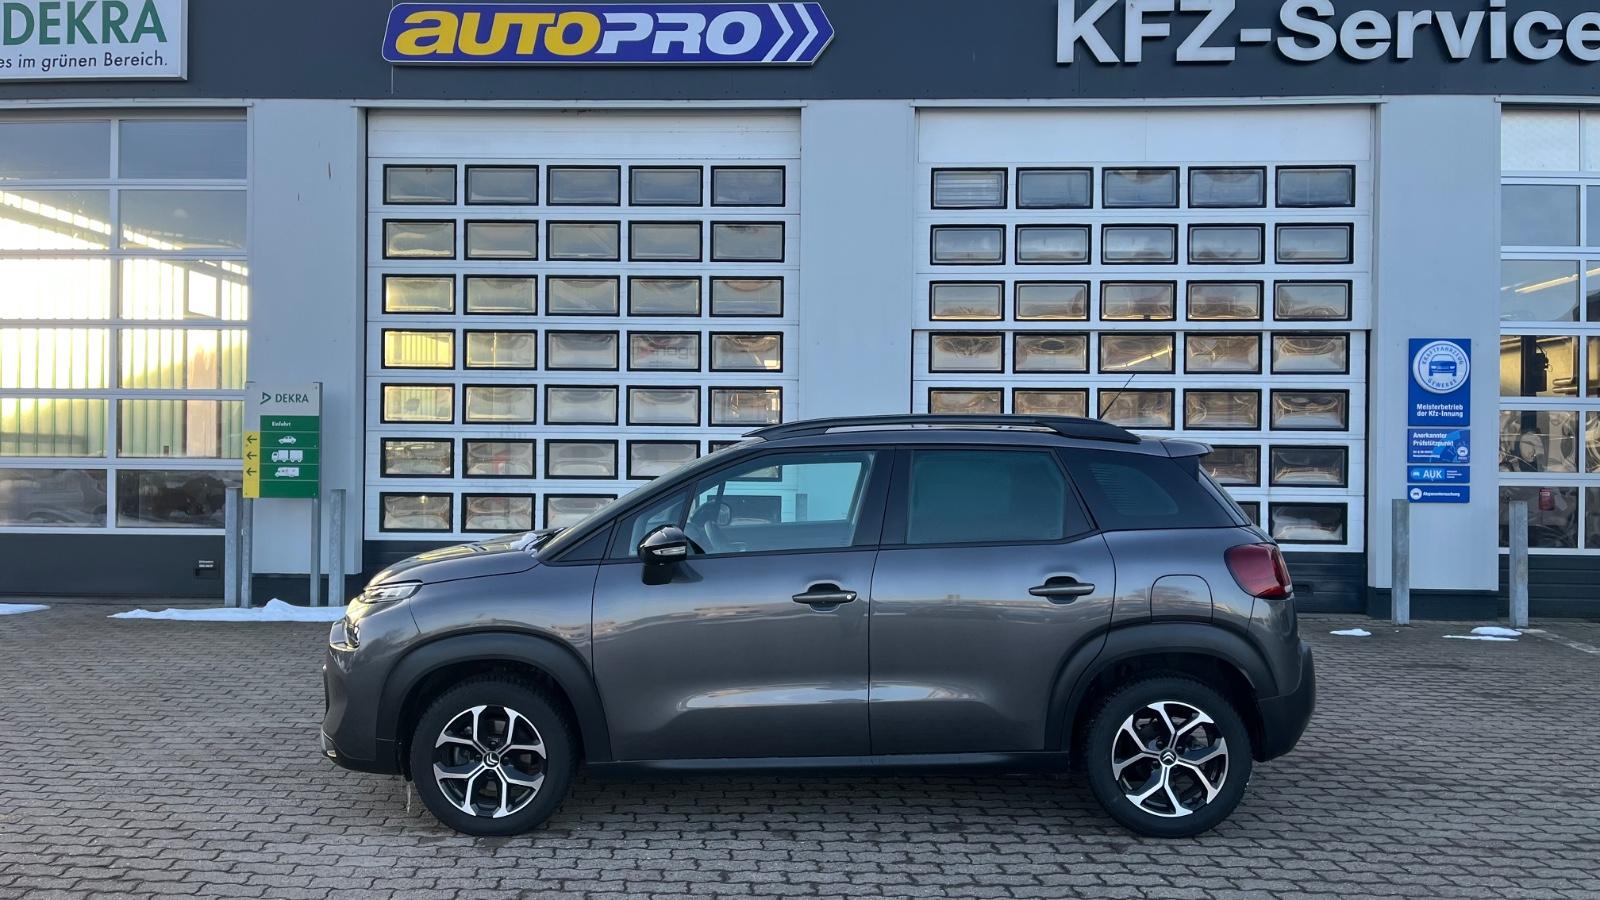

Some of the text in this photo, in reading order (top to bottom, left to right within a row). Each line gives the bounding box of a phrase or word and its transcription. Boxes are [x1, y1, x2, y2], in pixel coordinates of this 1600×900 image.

[3, 0, 167, 45] DEKRA
[1056, 0, 1600, 63] KFZ-Service
[18, 54, 35, 68] im
[41, 54, 97, 72] grünen
[104, 51, 168, 67] Bereich.
[275, 393, 309, 403] DEKRA
[1428, 410, 1463, 418] Kfz-Innung
[1423, 469, 1443, 479] AUK
